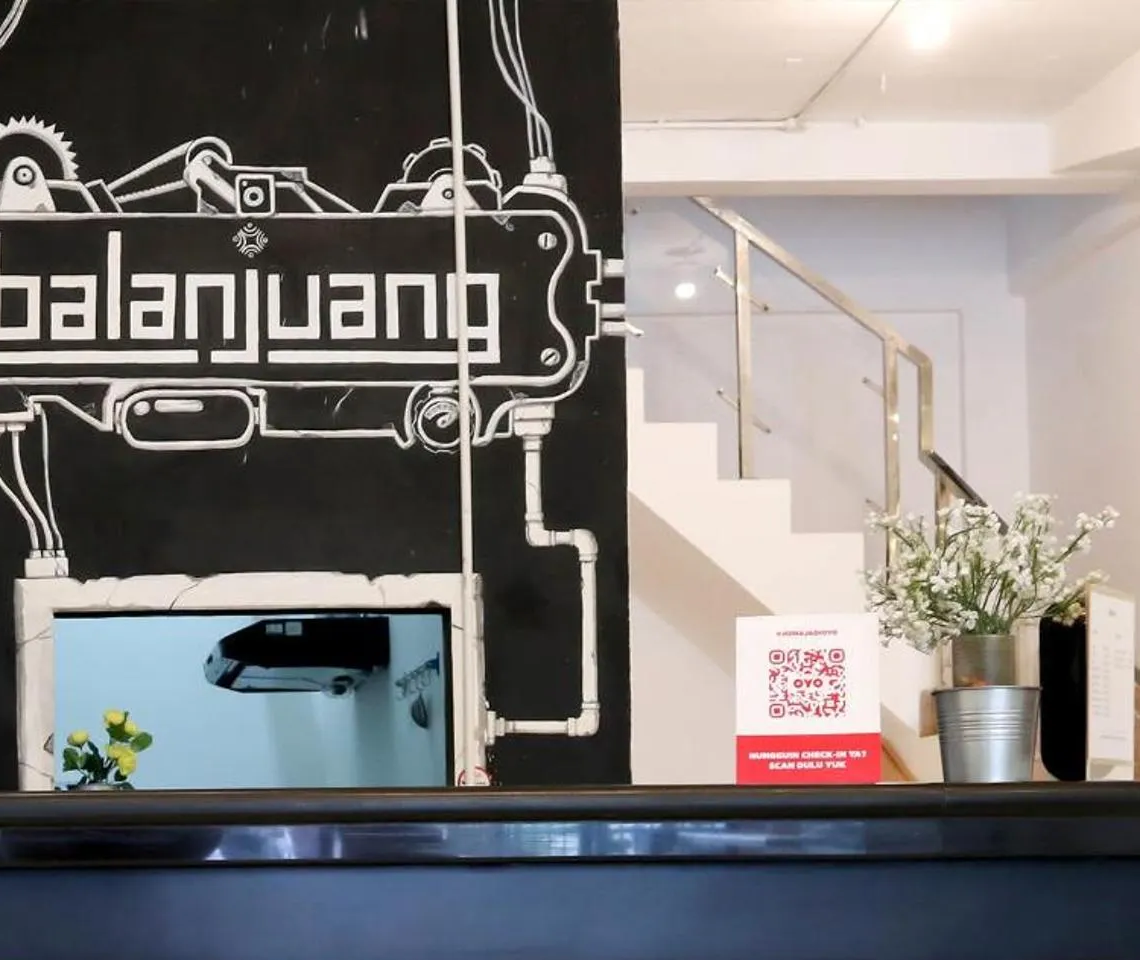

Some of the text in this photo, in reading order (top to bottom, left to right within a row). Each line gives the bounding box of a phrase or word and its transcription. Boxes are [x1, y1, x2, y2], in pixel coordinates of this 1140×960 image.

[801, 750, 847, 759] CHECK-IN
[769, 760, 846, 770] SCAN DULU YUK
